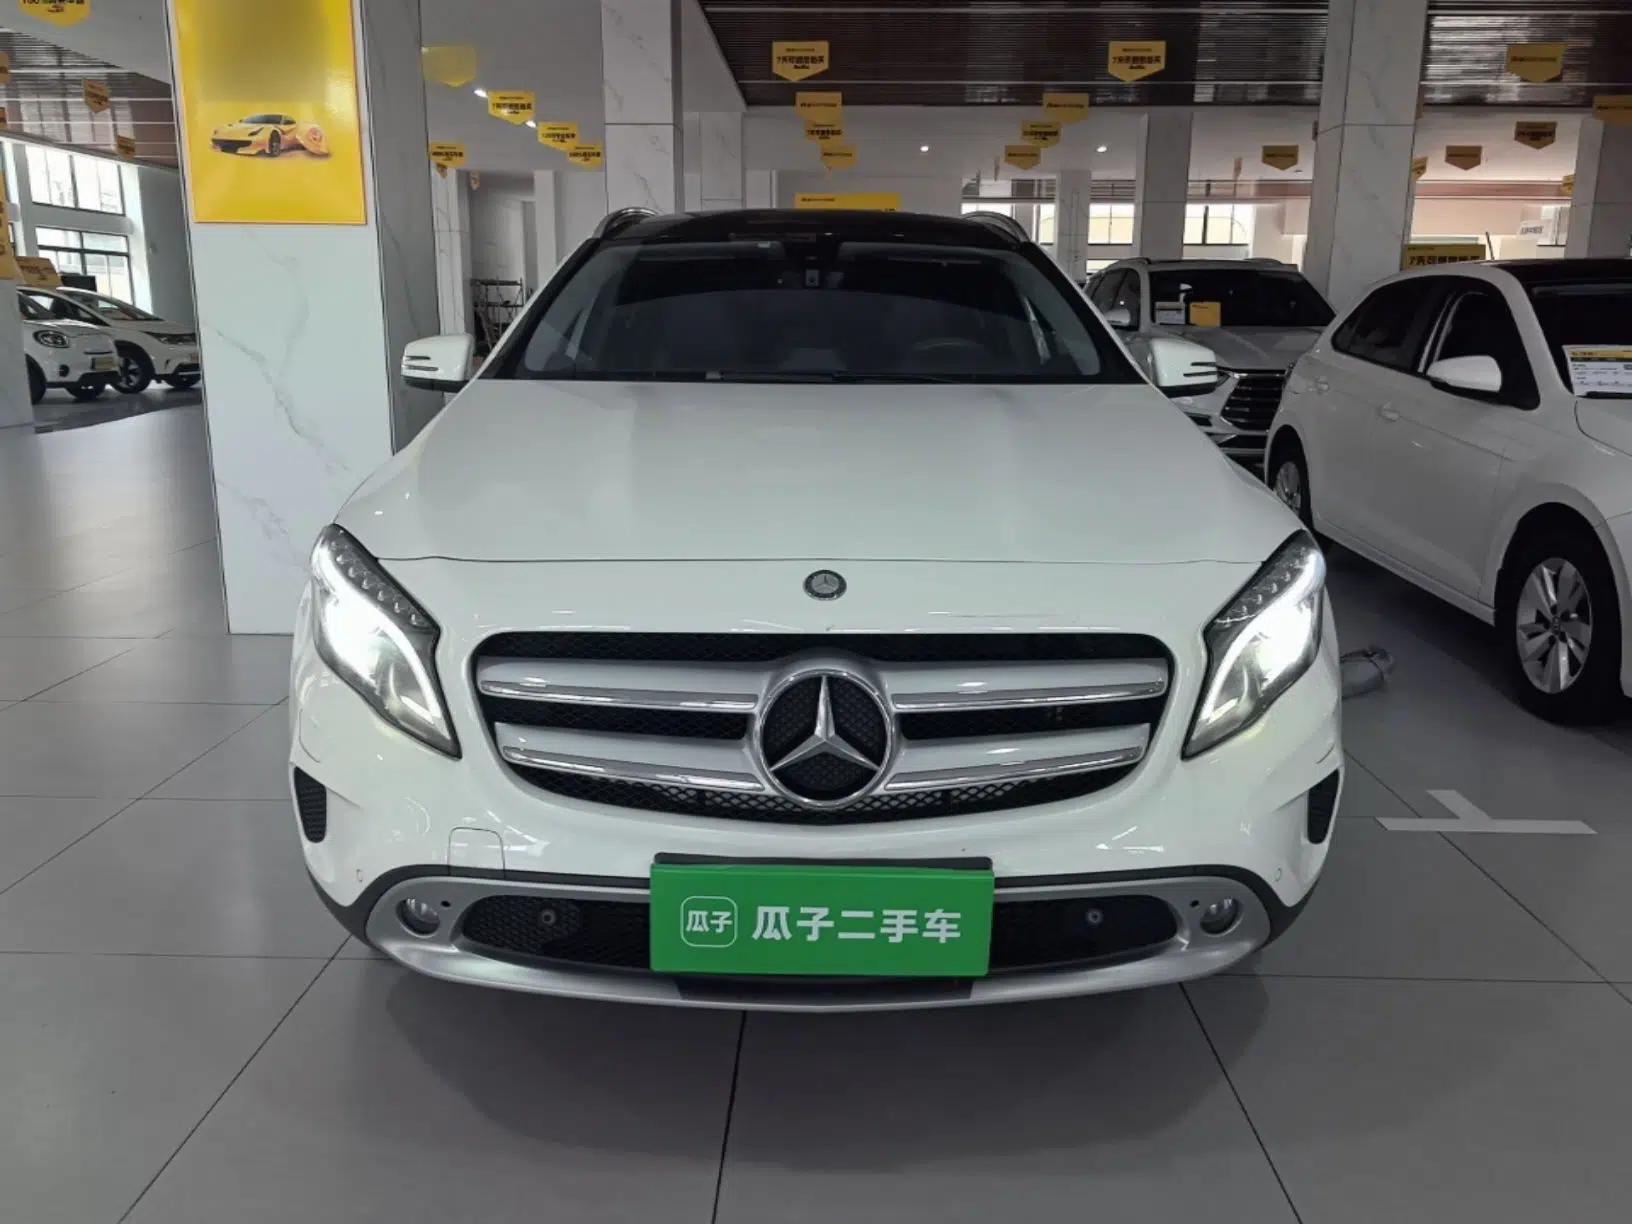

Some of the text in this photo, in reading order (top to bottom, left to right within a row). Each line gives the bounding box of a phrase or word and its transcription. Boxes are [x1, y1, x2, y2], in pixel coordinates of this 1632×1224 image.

[686, 906, 961, 943] 瓜子 瓜子二手车
